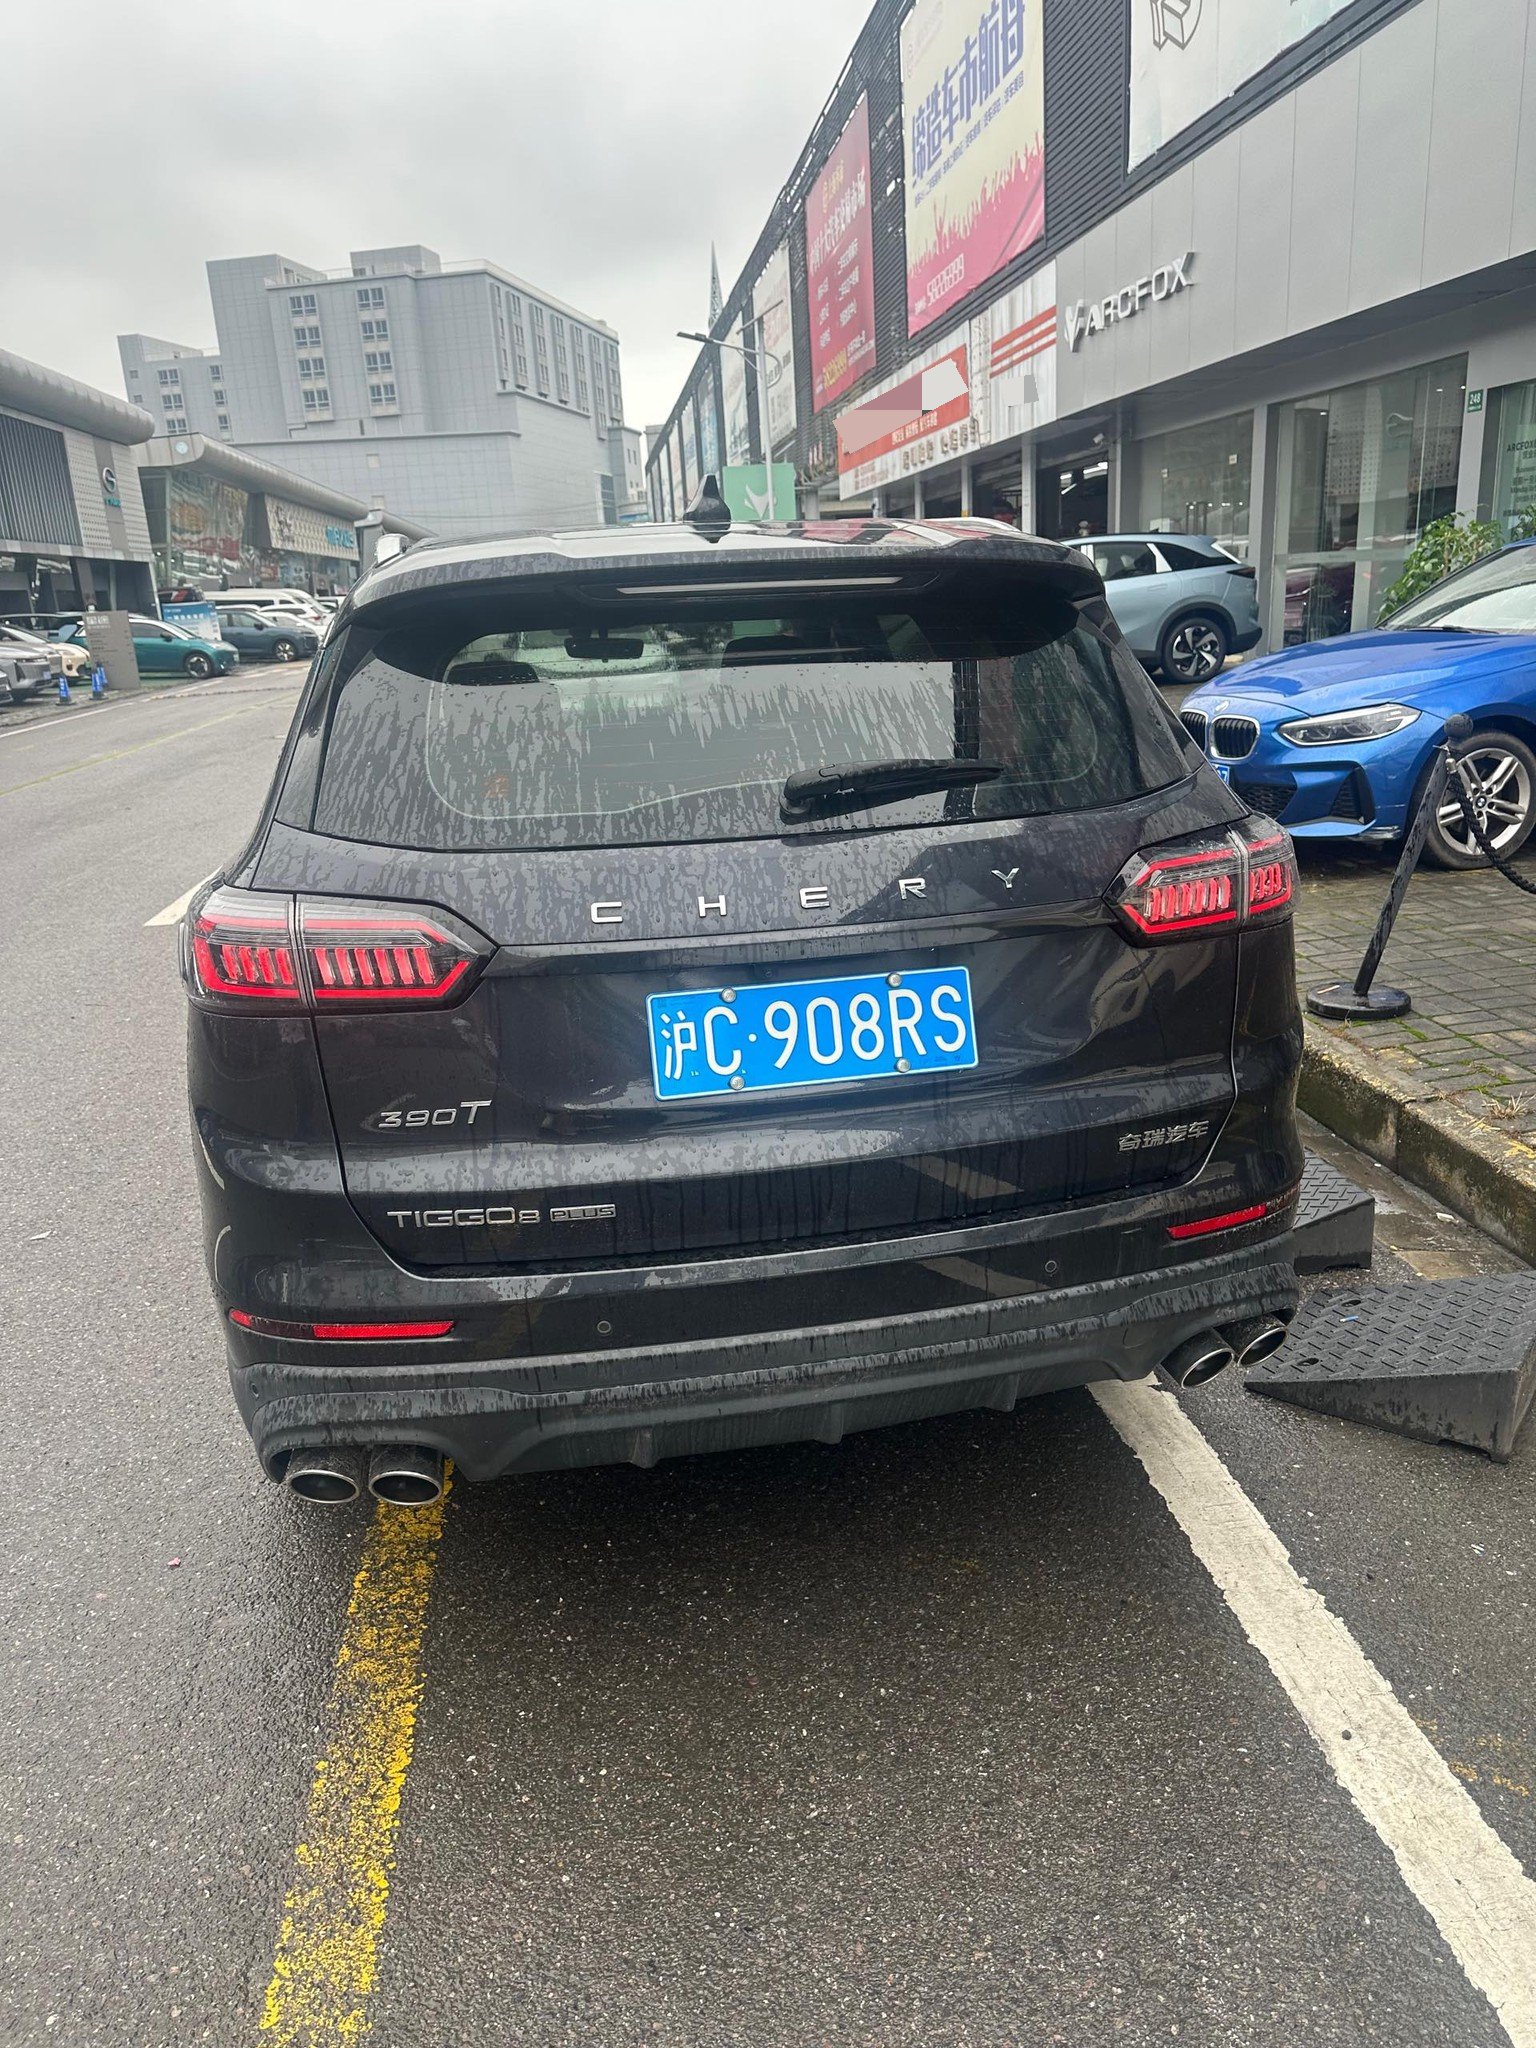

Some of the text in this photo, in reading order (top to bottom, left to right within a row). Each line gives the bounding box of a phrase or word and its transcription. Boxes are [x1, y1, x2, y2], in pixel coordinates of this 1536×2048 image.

[1085, 252, 1195, 336] ARCFOX
[1507, 439, 1536, 453] ARCFOX
[591, 867, 1020, 924] CHERY
[378, 1099, 493, 1129] 390T
[1118, 1120, 1210, 1152] 奇瑞汽车
[550, 1203, 617, 1223] PLUS
